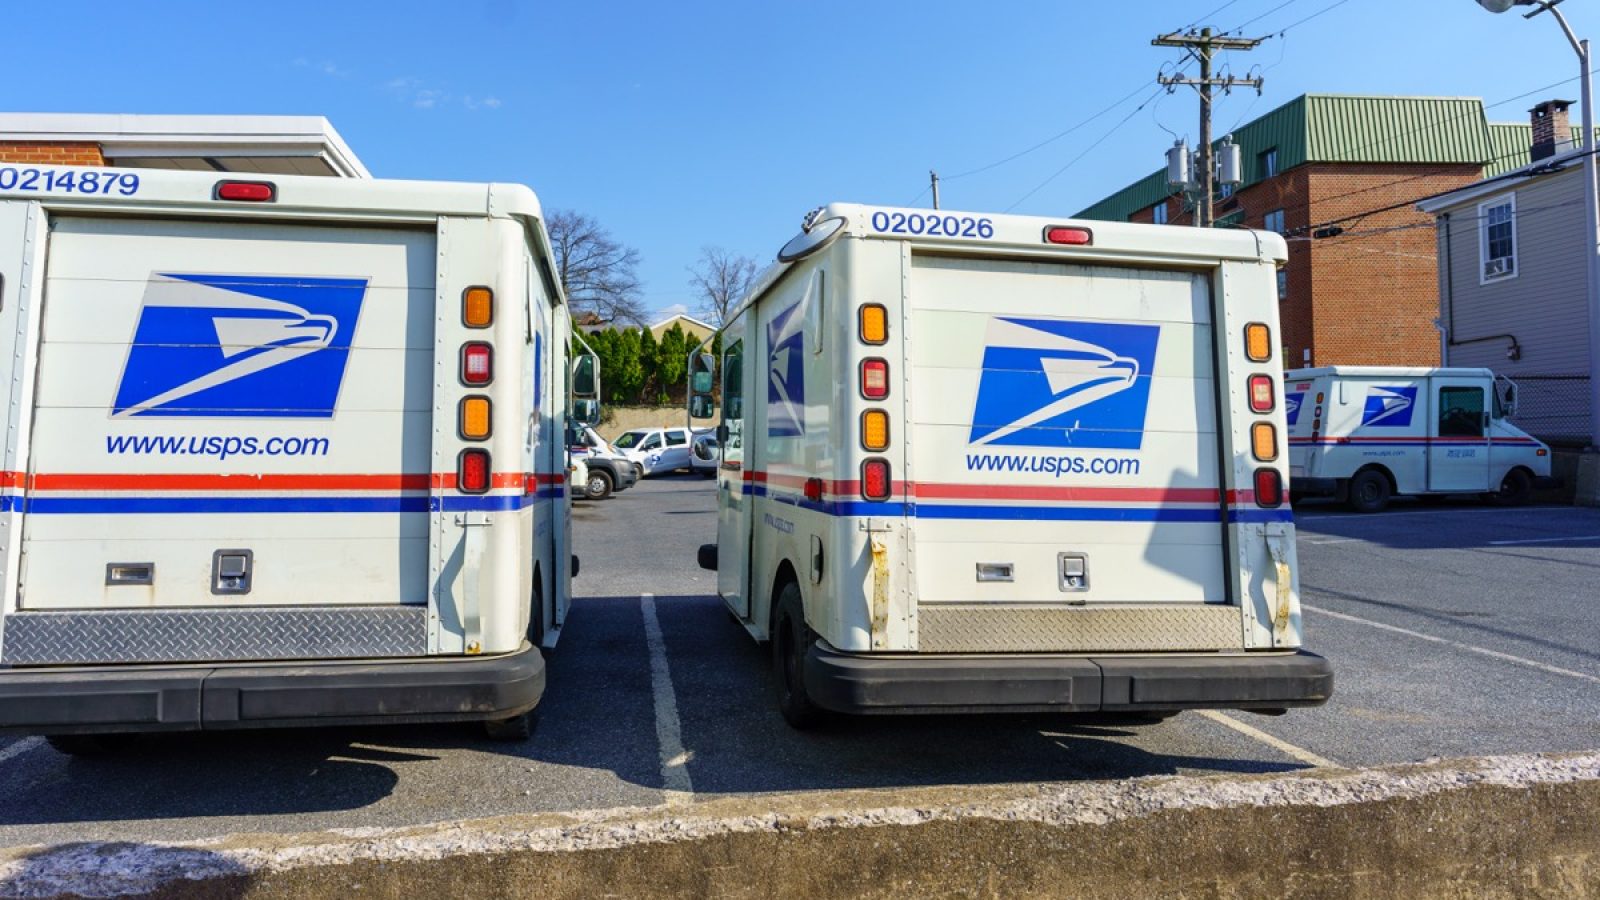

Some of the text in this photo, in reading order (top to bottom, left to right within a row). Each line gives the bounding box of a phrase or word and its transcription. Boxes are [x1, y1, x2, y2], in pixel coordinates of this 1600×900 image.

[0, 167, 140, 196] 0214879
[871, 211, 994, 239] 0202026
[106, 435, 329, 461] www.usps.com
[966, 454, 1140, 478] www.usps.com
